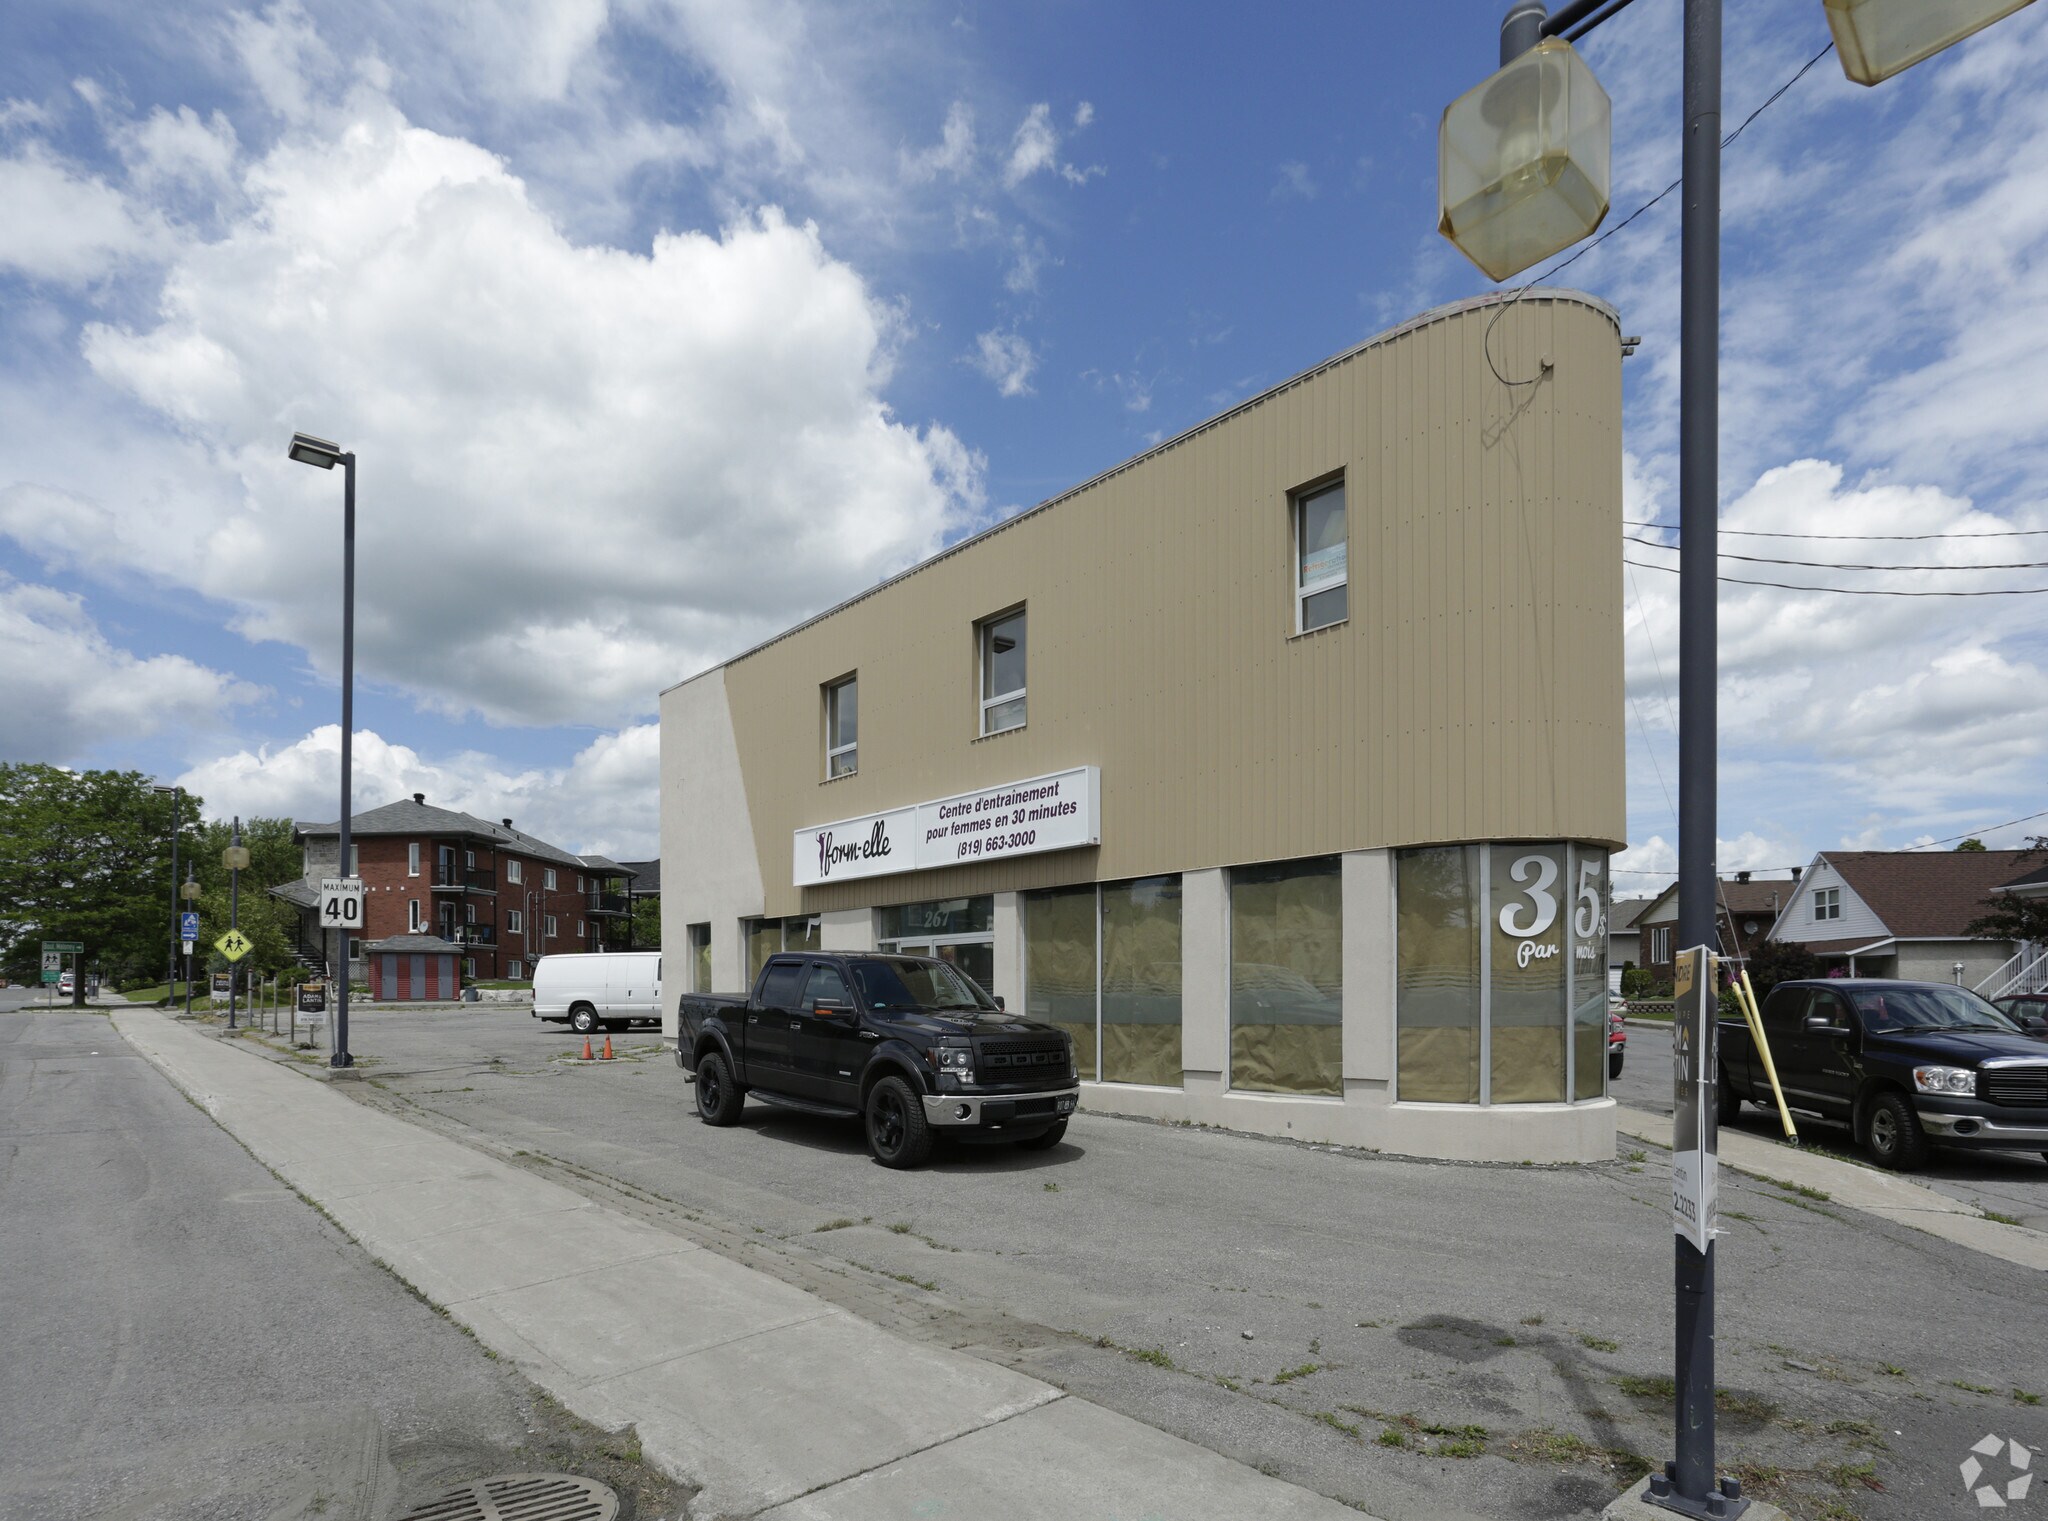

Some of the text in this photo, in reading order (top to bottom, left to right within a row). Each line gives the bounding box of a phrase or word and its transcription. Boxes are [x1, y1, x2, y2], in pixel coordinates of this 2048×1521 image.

[939, 781, 1059, 820] Centre d'entraînement
[926, 801, 1077, 844] pour femmes en 30 minutes
[824, 819, 892, 876] form-elle
[957, 839, 982, 859] (819)
[323, 883, 360, 892] MAXIMUM
[325, 897, 357, 920] 40
[924, 911, 950, 928] 267
[1517, 940, 1597, 968] Par mois
